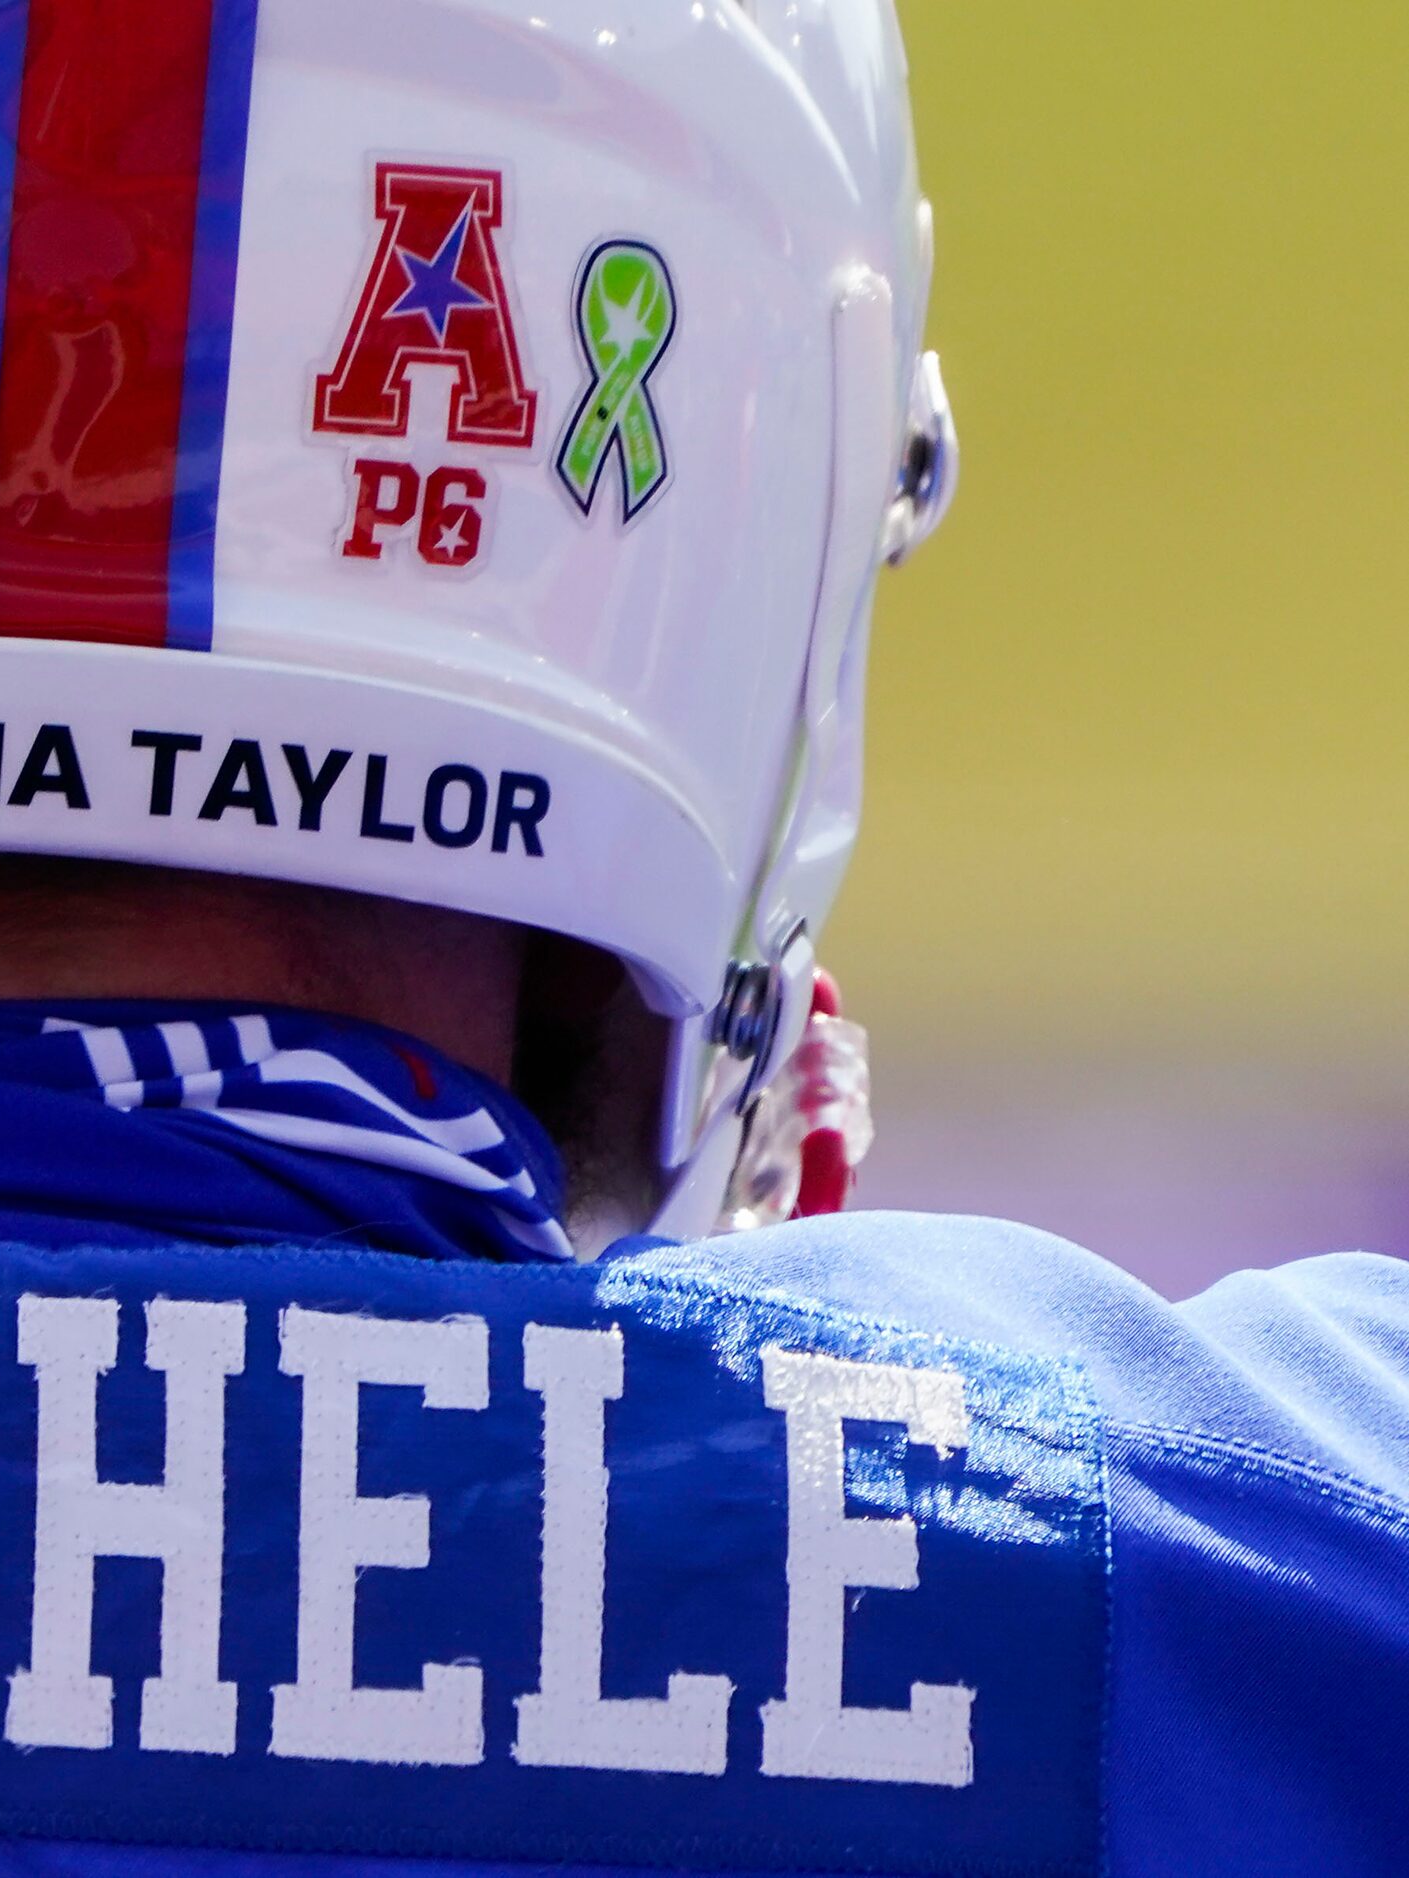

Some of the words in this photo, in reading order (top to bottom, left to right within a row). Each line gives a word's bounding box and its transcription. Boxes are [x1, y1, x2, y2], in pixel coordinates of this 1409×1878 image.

[312, 162, 537, 447] A
[342, 459, 486, 567] P6
[130, 729, 552, 859] TAYLOR
